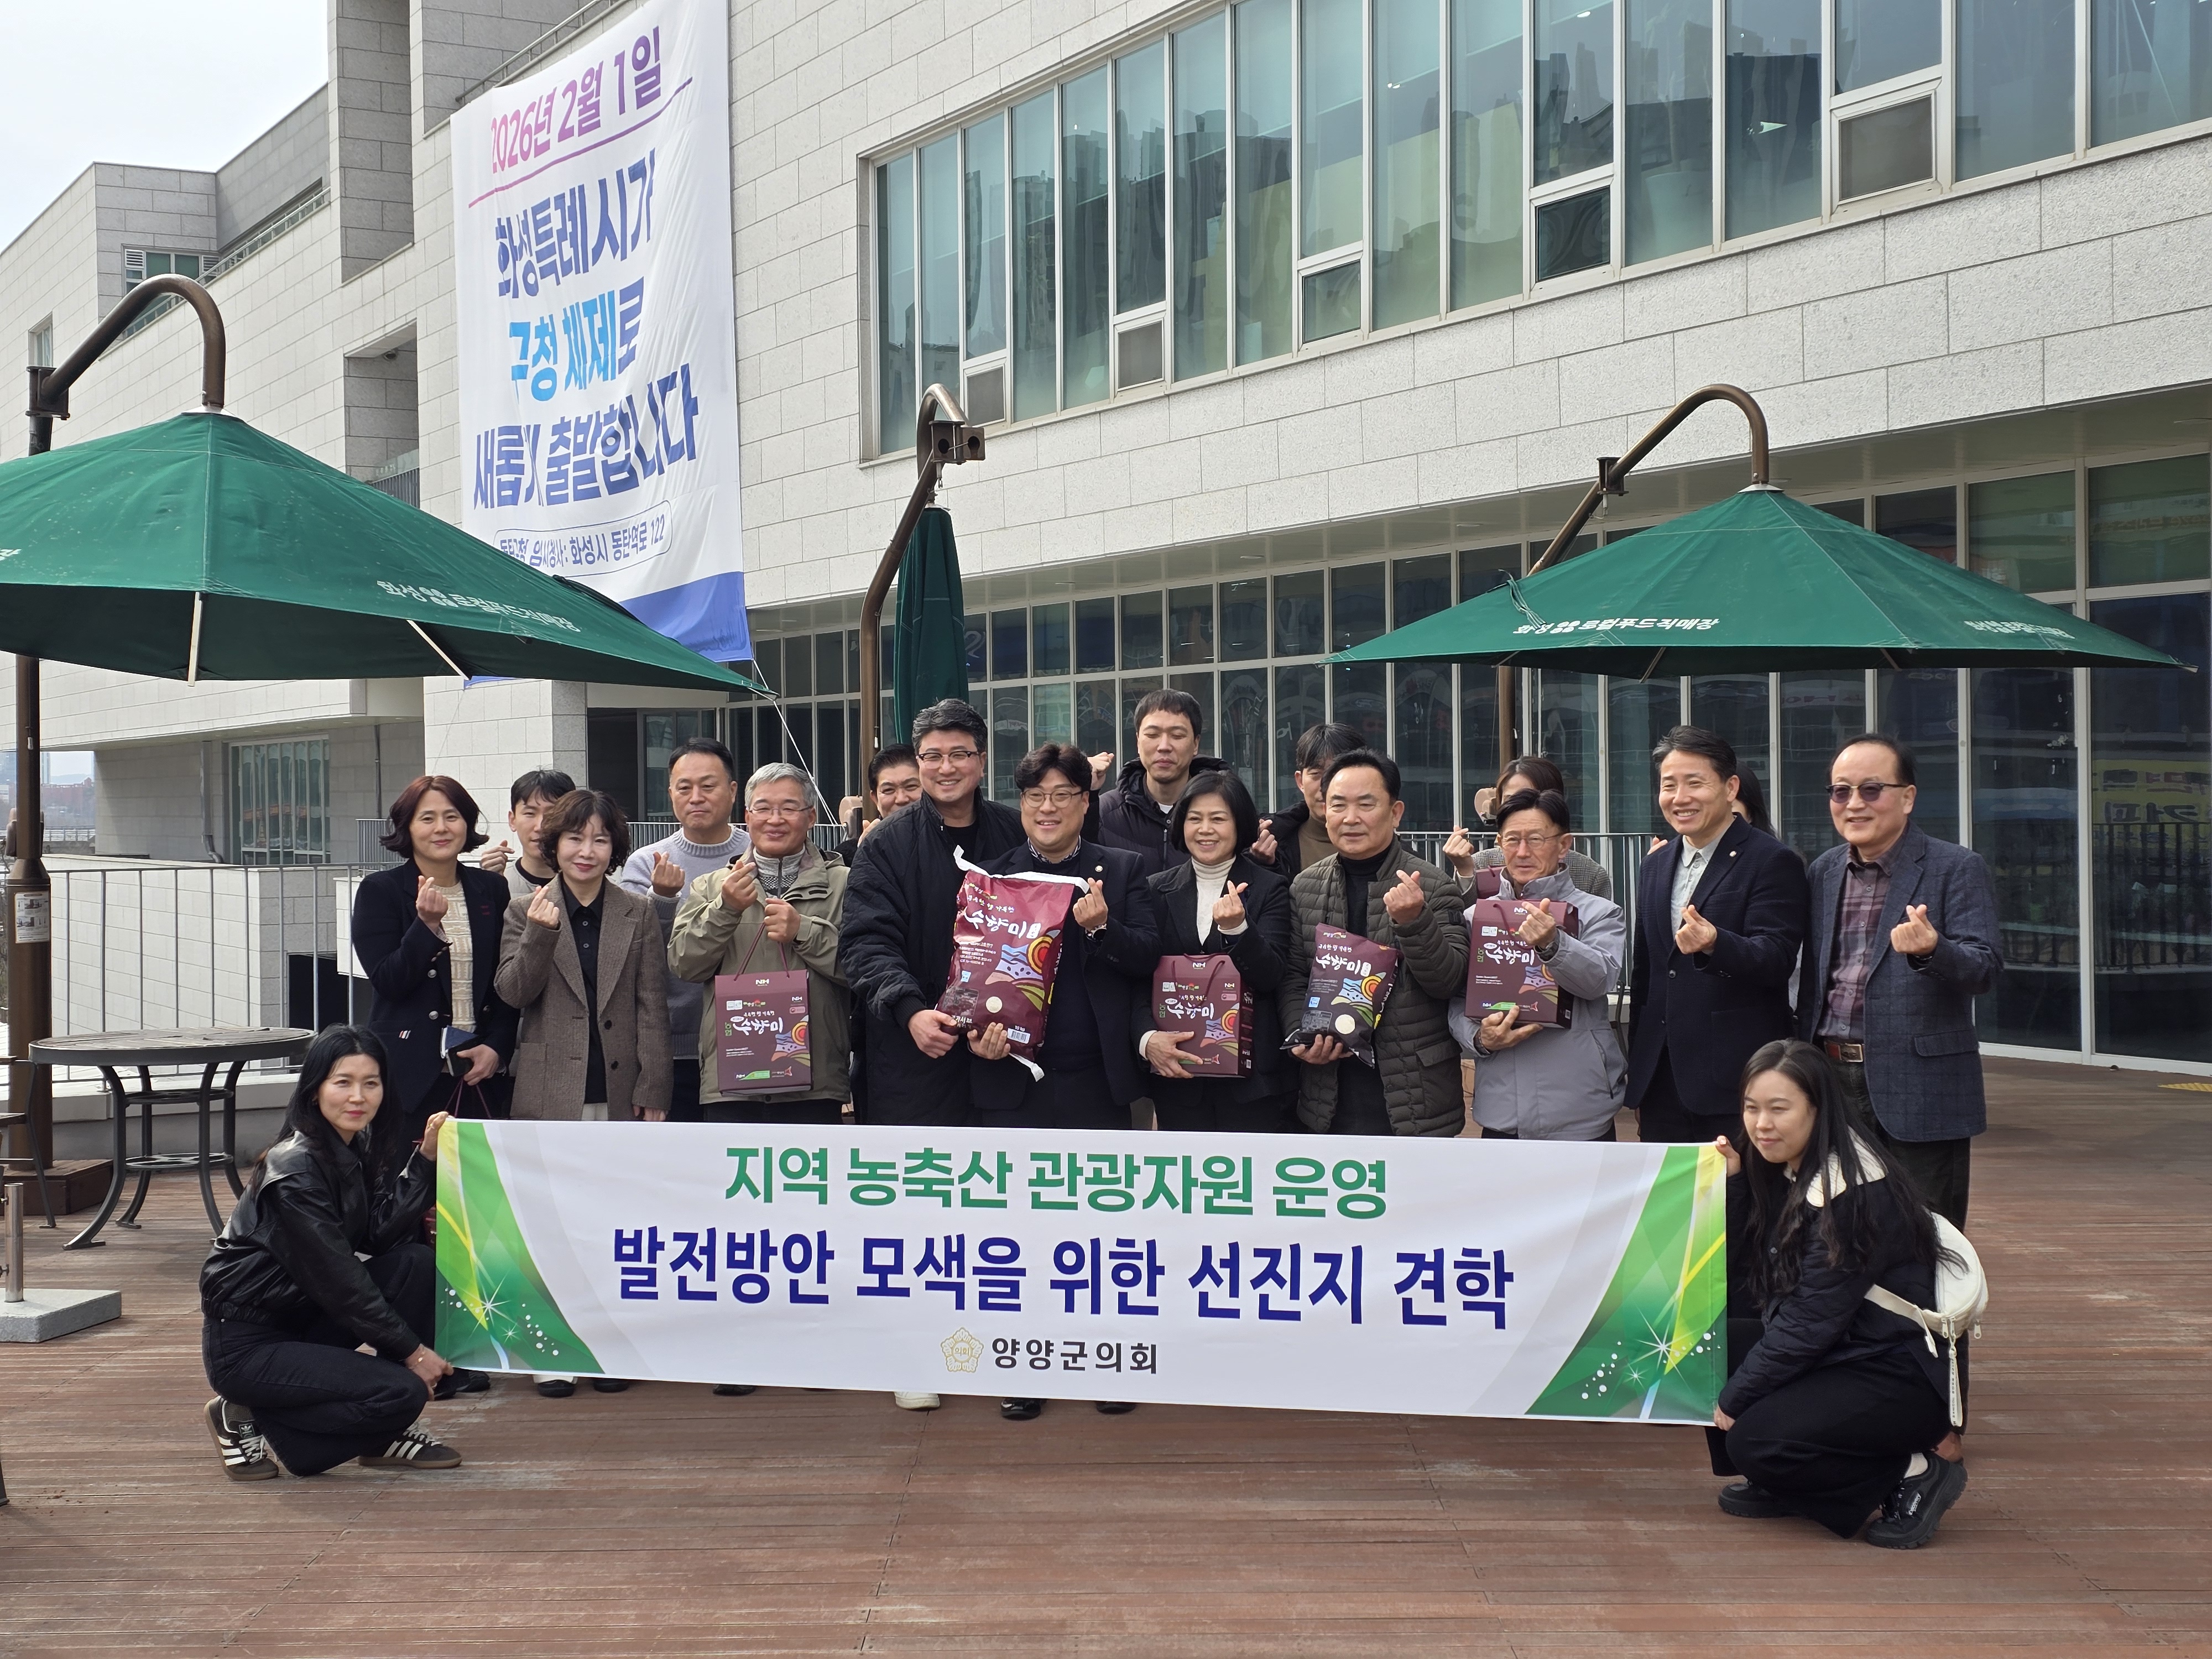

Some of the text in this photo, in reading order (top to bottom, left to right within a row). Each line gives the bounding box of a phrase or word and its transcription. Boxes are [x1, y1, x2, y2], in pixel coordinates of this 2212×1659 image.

[491, 25, 661, 174] 2026년 2월 1일
[495, 148, 655, 299] 화성특례시가
[509, 276, 644, 404] 구청 체제로
[545, 363, 699, 505] 출발합니다
[570, 533, 609, 565] 화성시
[611, 521, 647, 561] 동탄역로
[650, 514, 665, 546] 122
[448, 593, 581, 633] 로컬푸드직매장
[1577, 617, 1721, 631] 로컬푸드직매장
[964, 910, 1027, 938] 수향미
[1316, 953, 1361, 974] 수향미
[1485, 946, 1535, 966] 수향미
[733, 1017, 783, 1036] 수향미
[1167, 1002, 1214, 1019] 수향미
[726, 1147, 1386, 1219] 지역 농축산 관광자원 운영
[614, 1225, 1514, 1331] 발전방안 모색을 위한 선진지 견학
[992, 1338, 1157, 1374] 양양군의회
